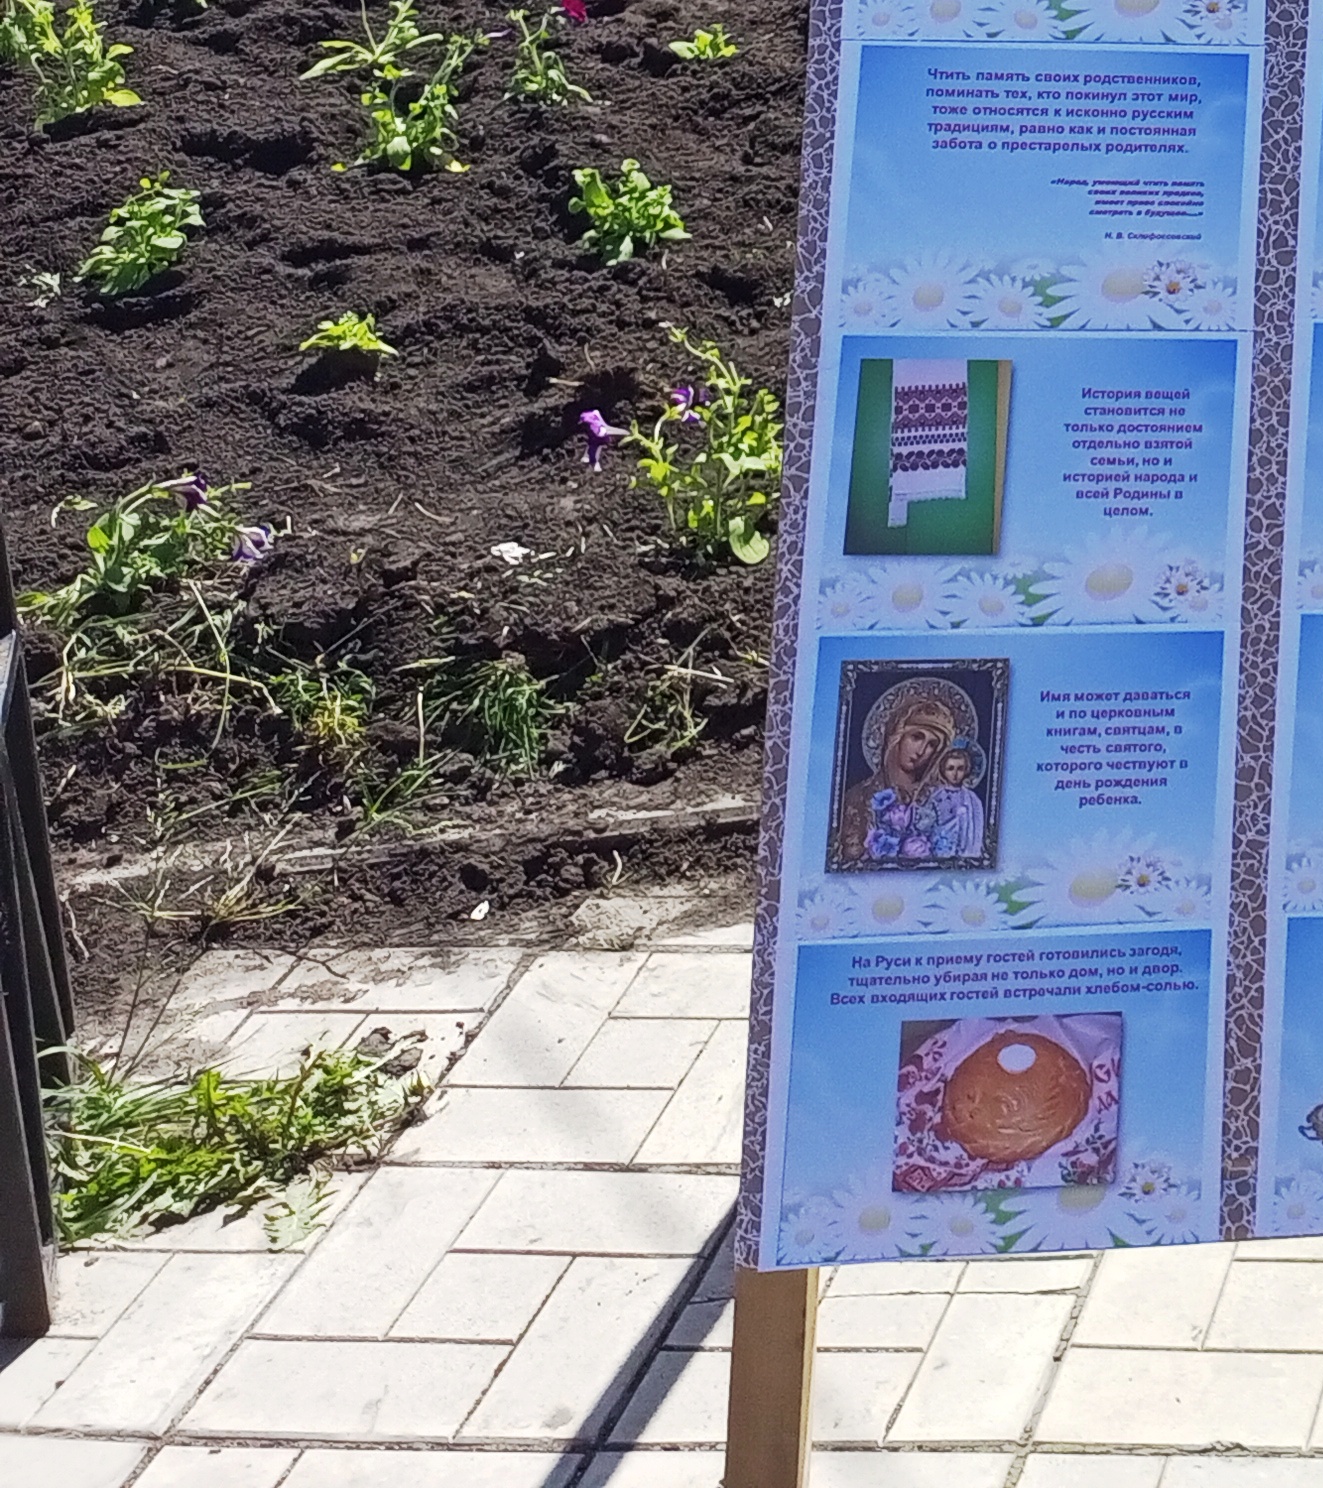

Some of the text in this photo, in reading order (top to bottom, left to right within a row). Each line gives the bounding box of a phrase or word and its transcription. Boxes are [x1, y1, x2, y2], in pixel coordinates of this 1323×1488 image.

[928, 68, 1201, 87] Чтить память своих родственников,
[1082, 388, 1190, 401] История вещей
[852, 945, 1182, 970] На Руси к приему гостей готовились загодя,
